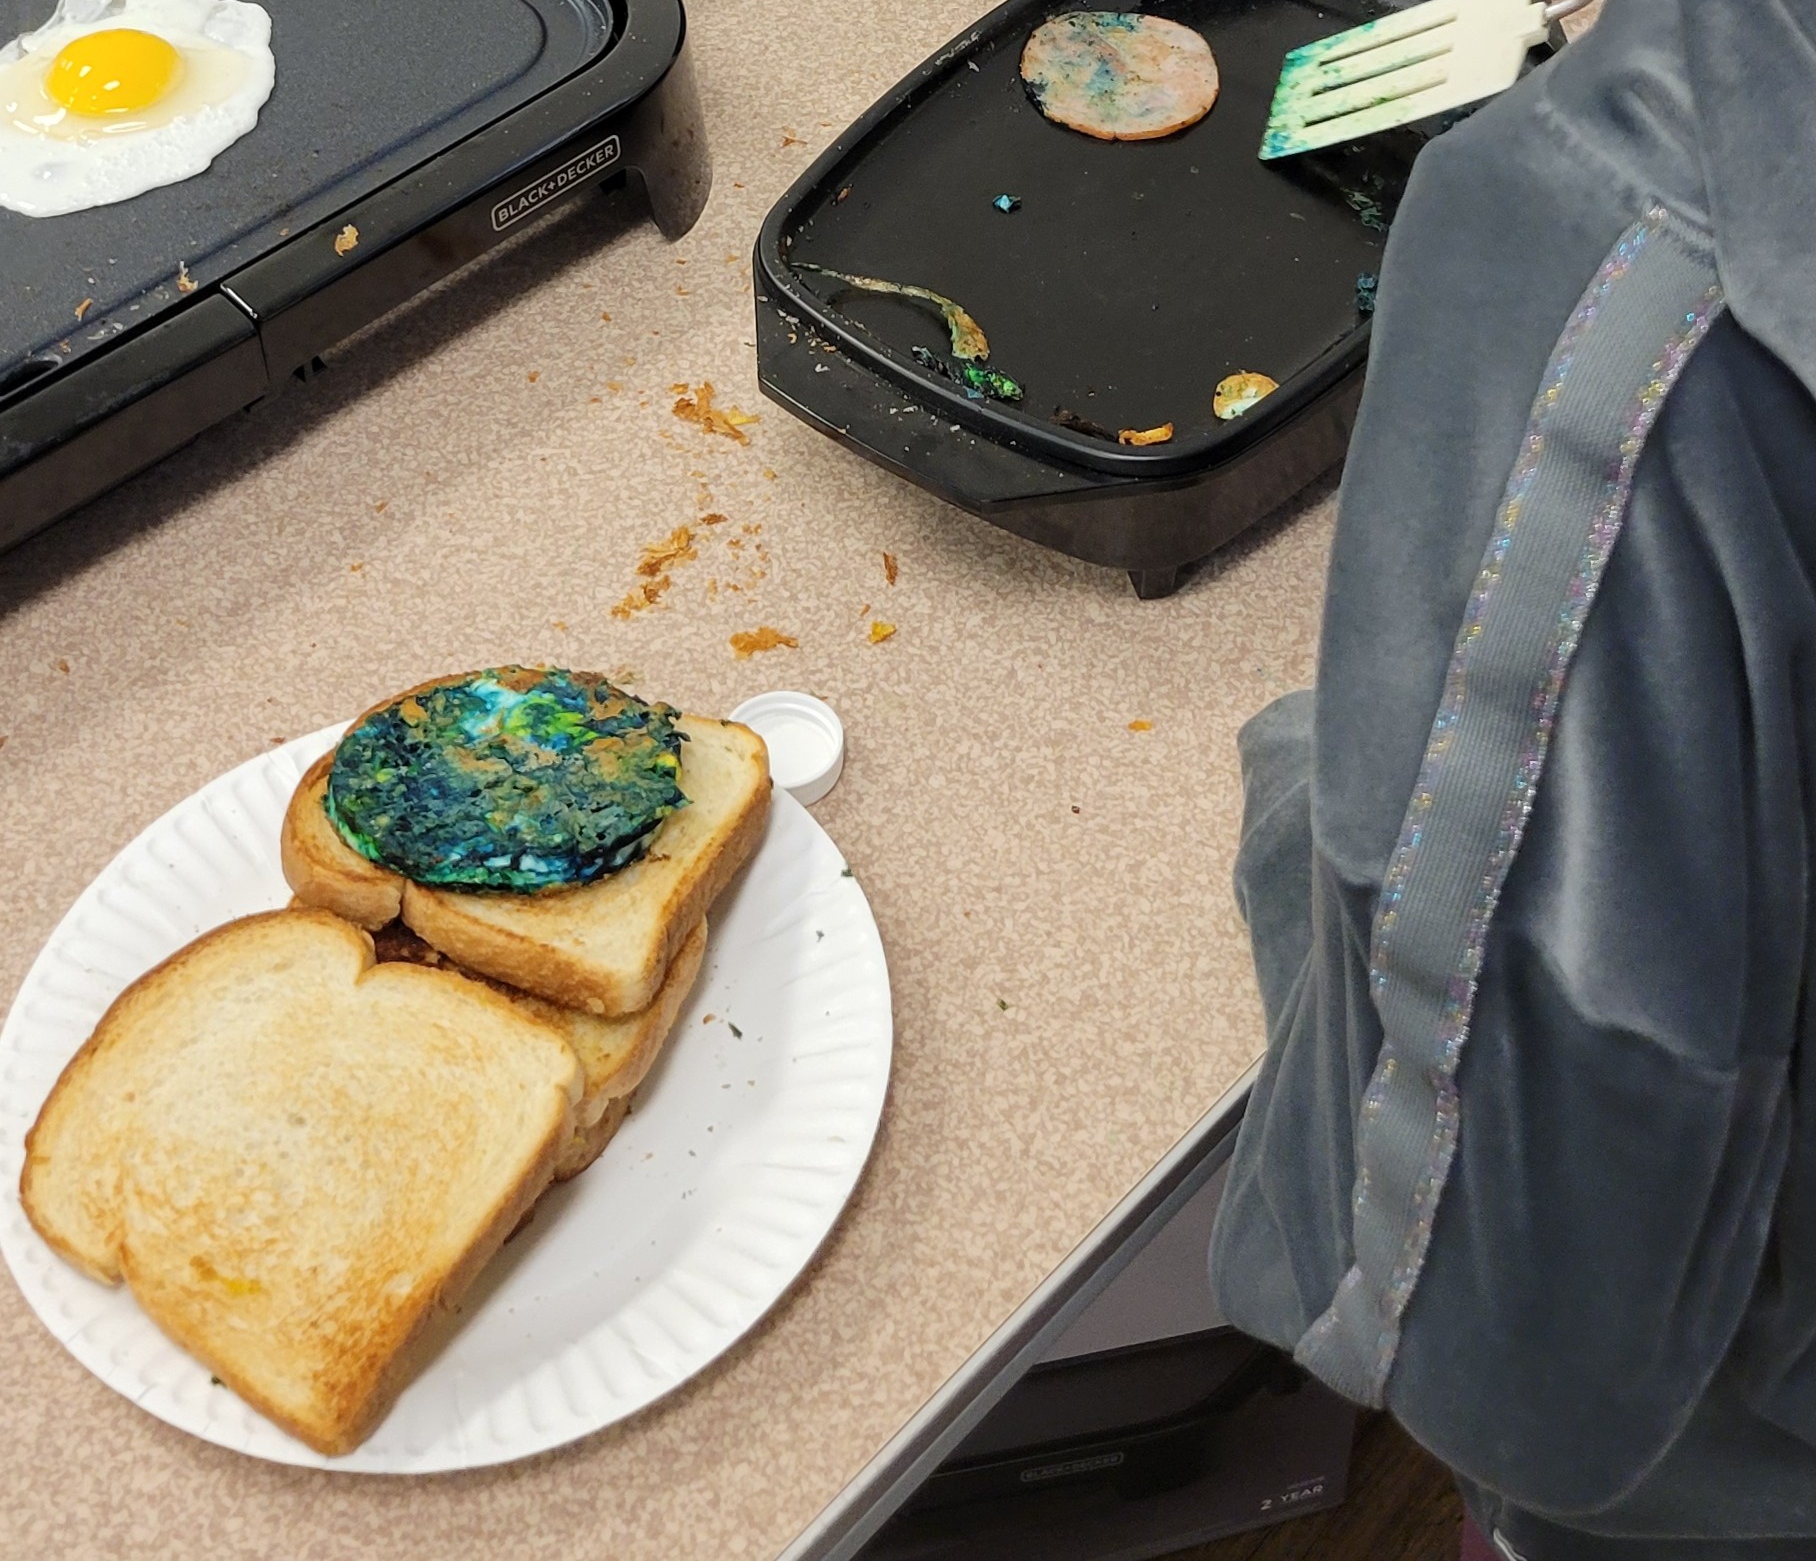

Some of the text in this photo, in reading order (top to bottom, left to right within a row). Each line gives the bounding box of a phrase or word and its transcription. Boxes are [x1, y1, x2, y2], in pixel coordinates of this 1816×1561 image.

[498, 144, 615, 222] BLACK+DECKER
[1261, 1485, 1323, 1511] 2 YEAR
